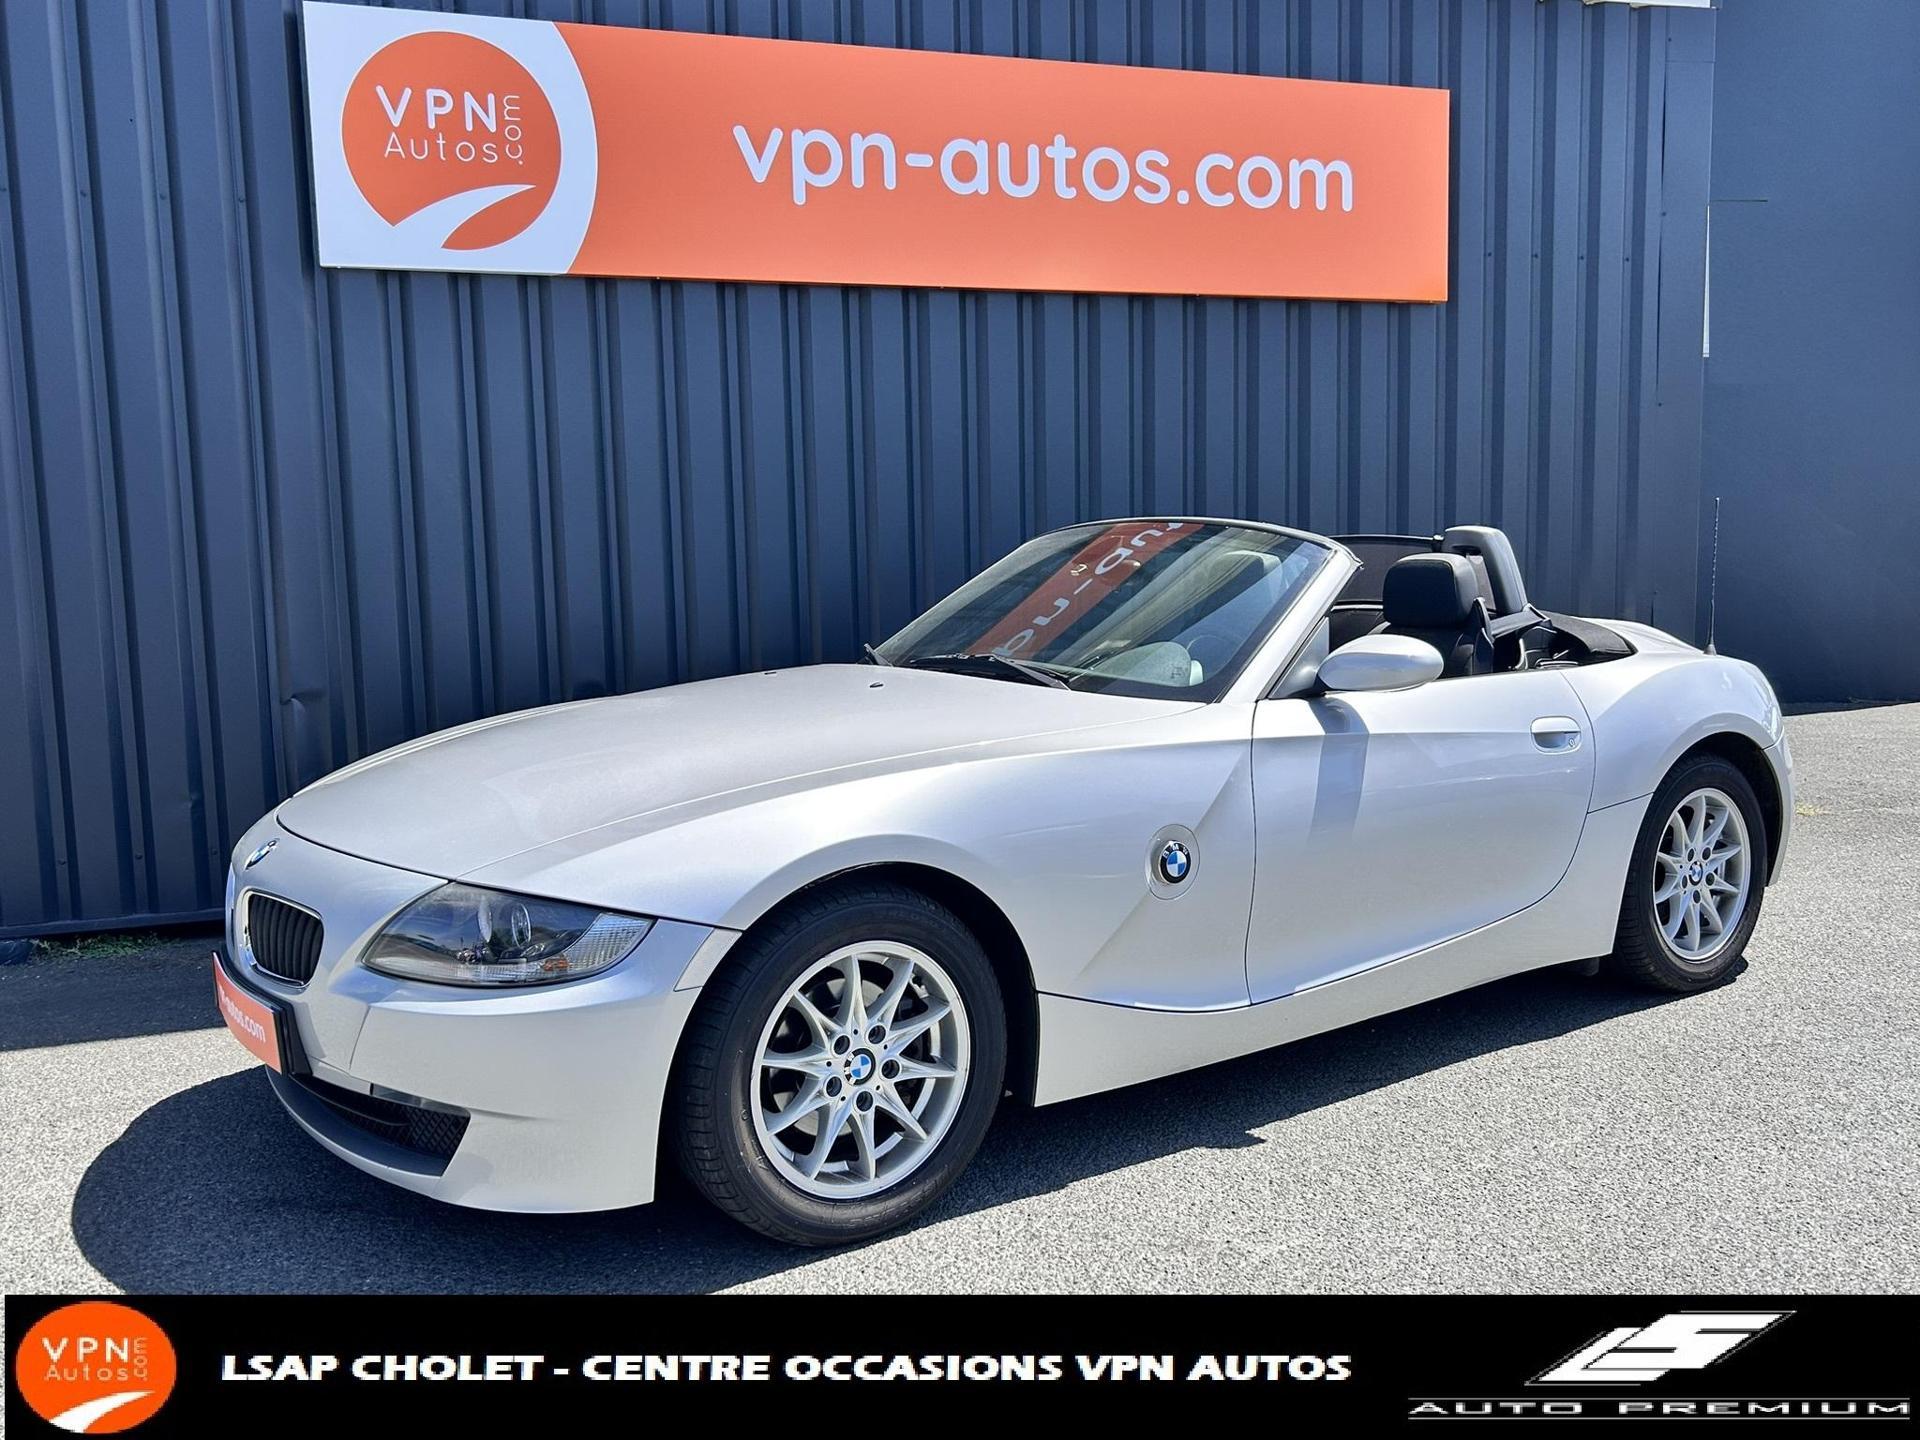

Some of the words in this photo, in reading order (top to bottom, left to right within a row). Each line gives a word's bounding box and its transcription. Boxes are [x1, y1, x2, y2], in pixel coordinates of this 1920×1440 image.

[375, 84, 498, 133] VPN
[384, 131, 498, 164] Autos
[732, 125, 1354, 212] vpn-autos.com
